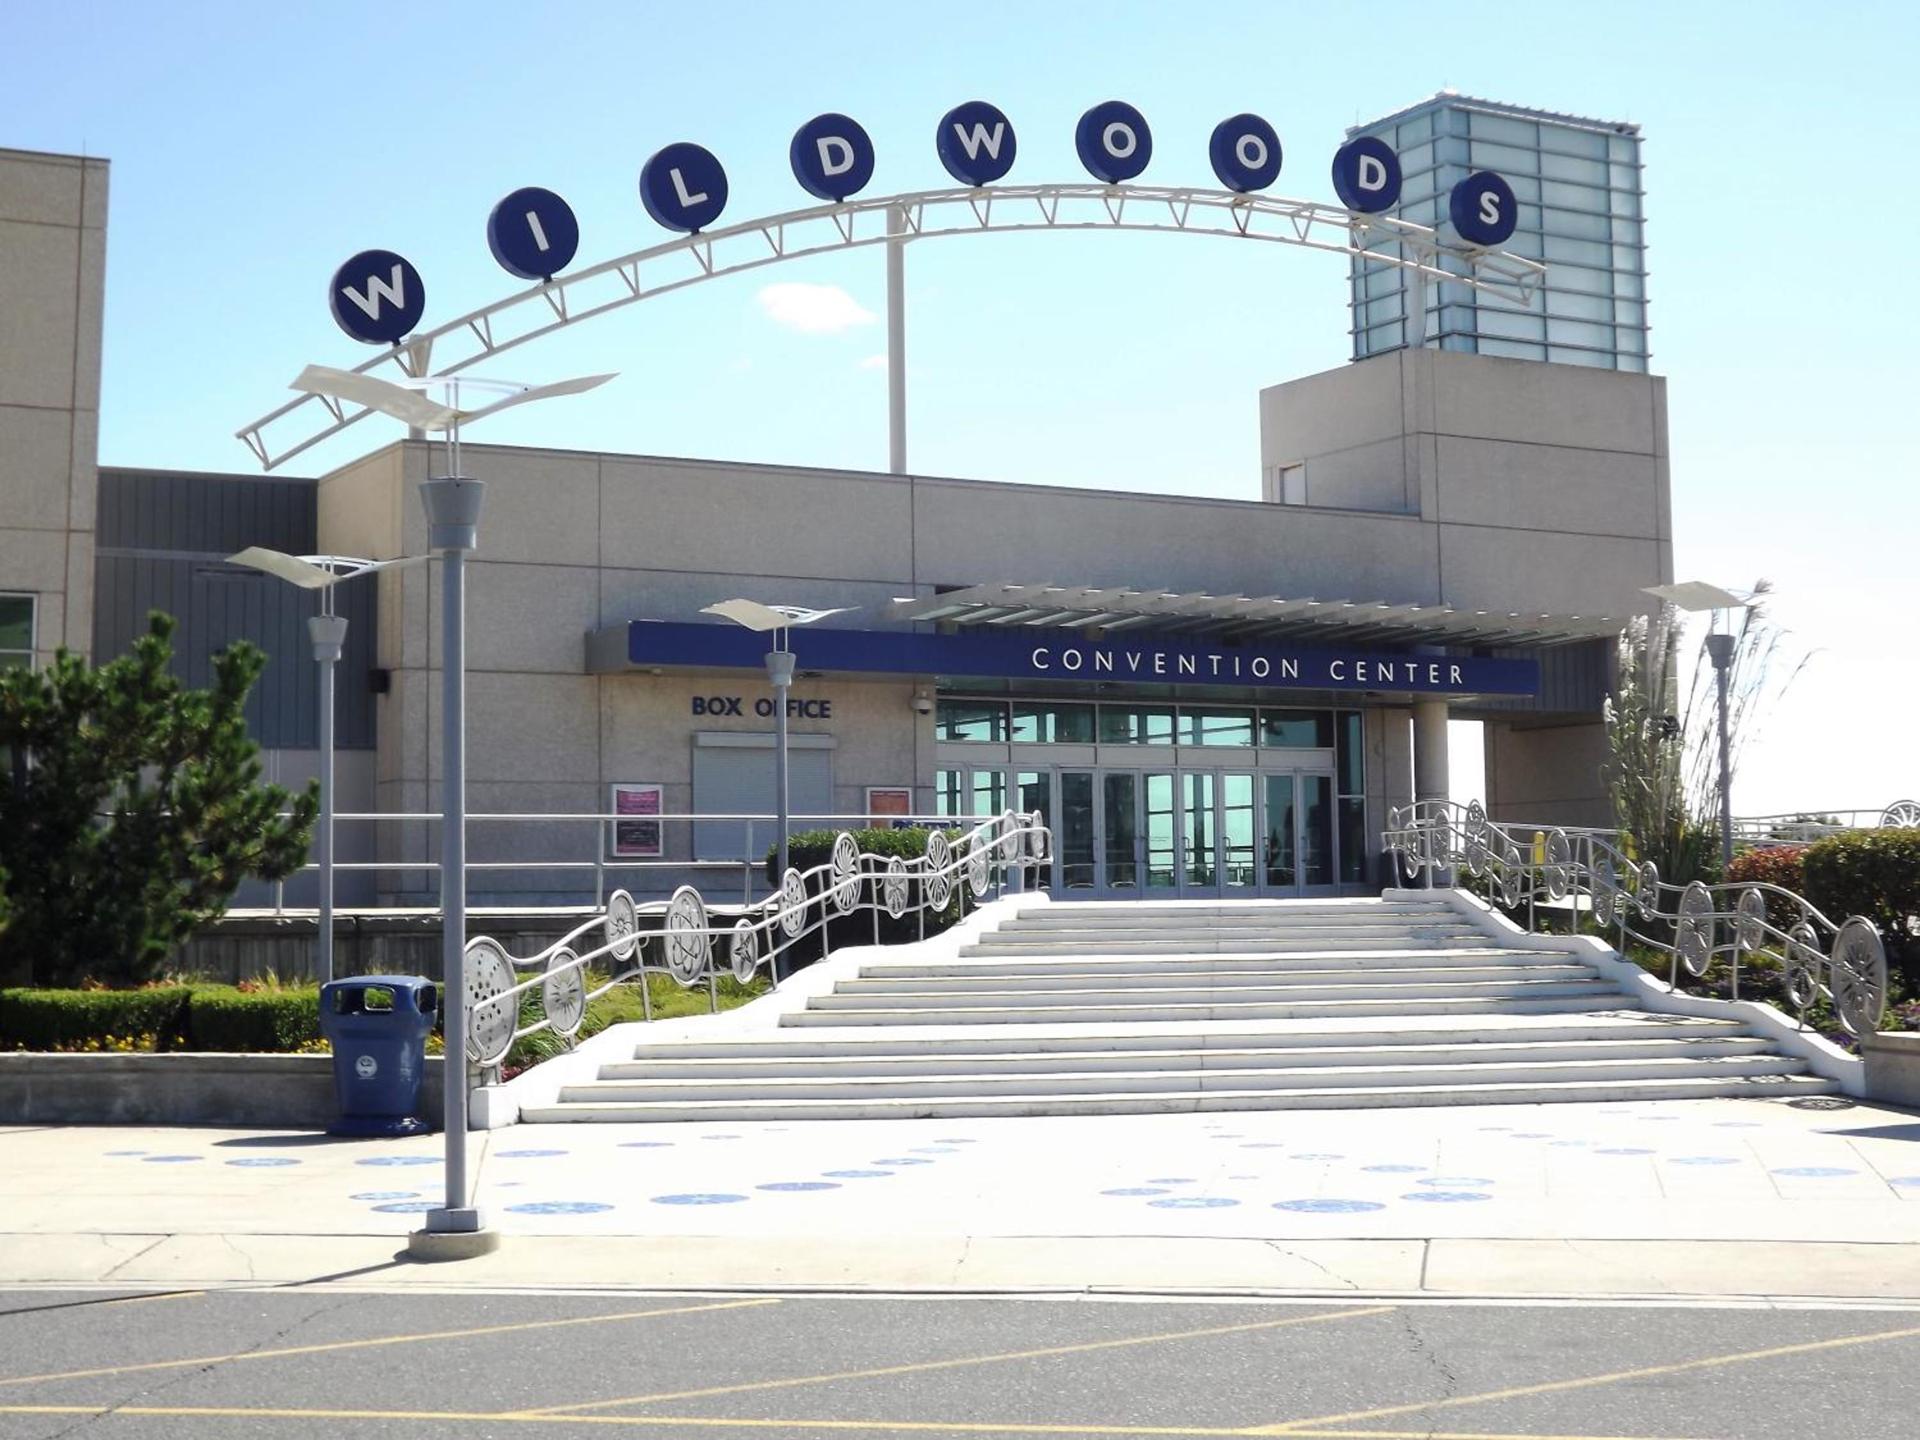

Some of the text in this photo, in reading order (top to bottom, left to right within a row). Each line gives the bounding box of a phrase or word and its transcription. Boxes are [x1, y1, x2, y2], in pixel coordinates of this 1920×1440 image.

[342, 121, 1501, 322] WILDWOODS
[1032, 646, 1464, 685] CONVENTION CENTER
[692, 695, 743, 716] BOX
